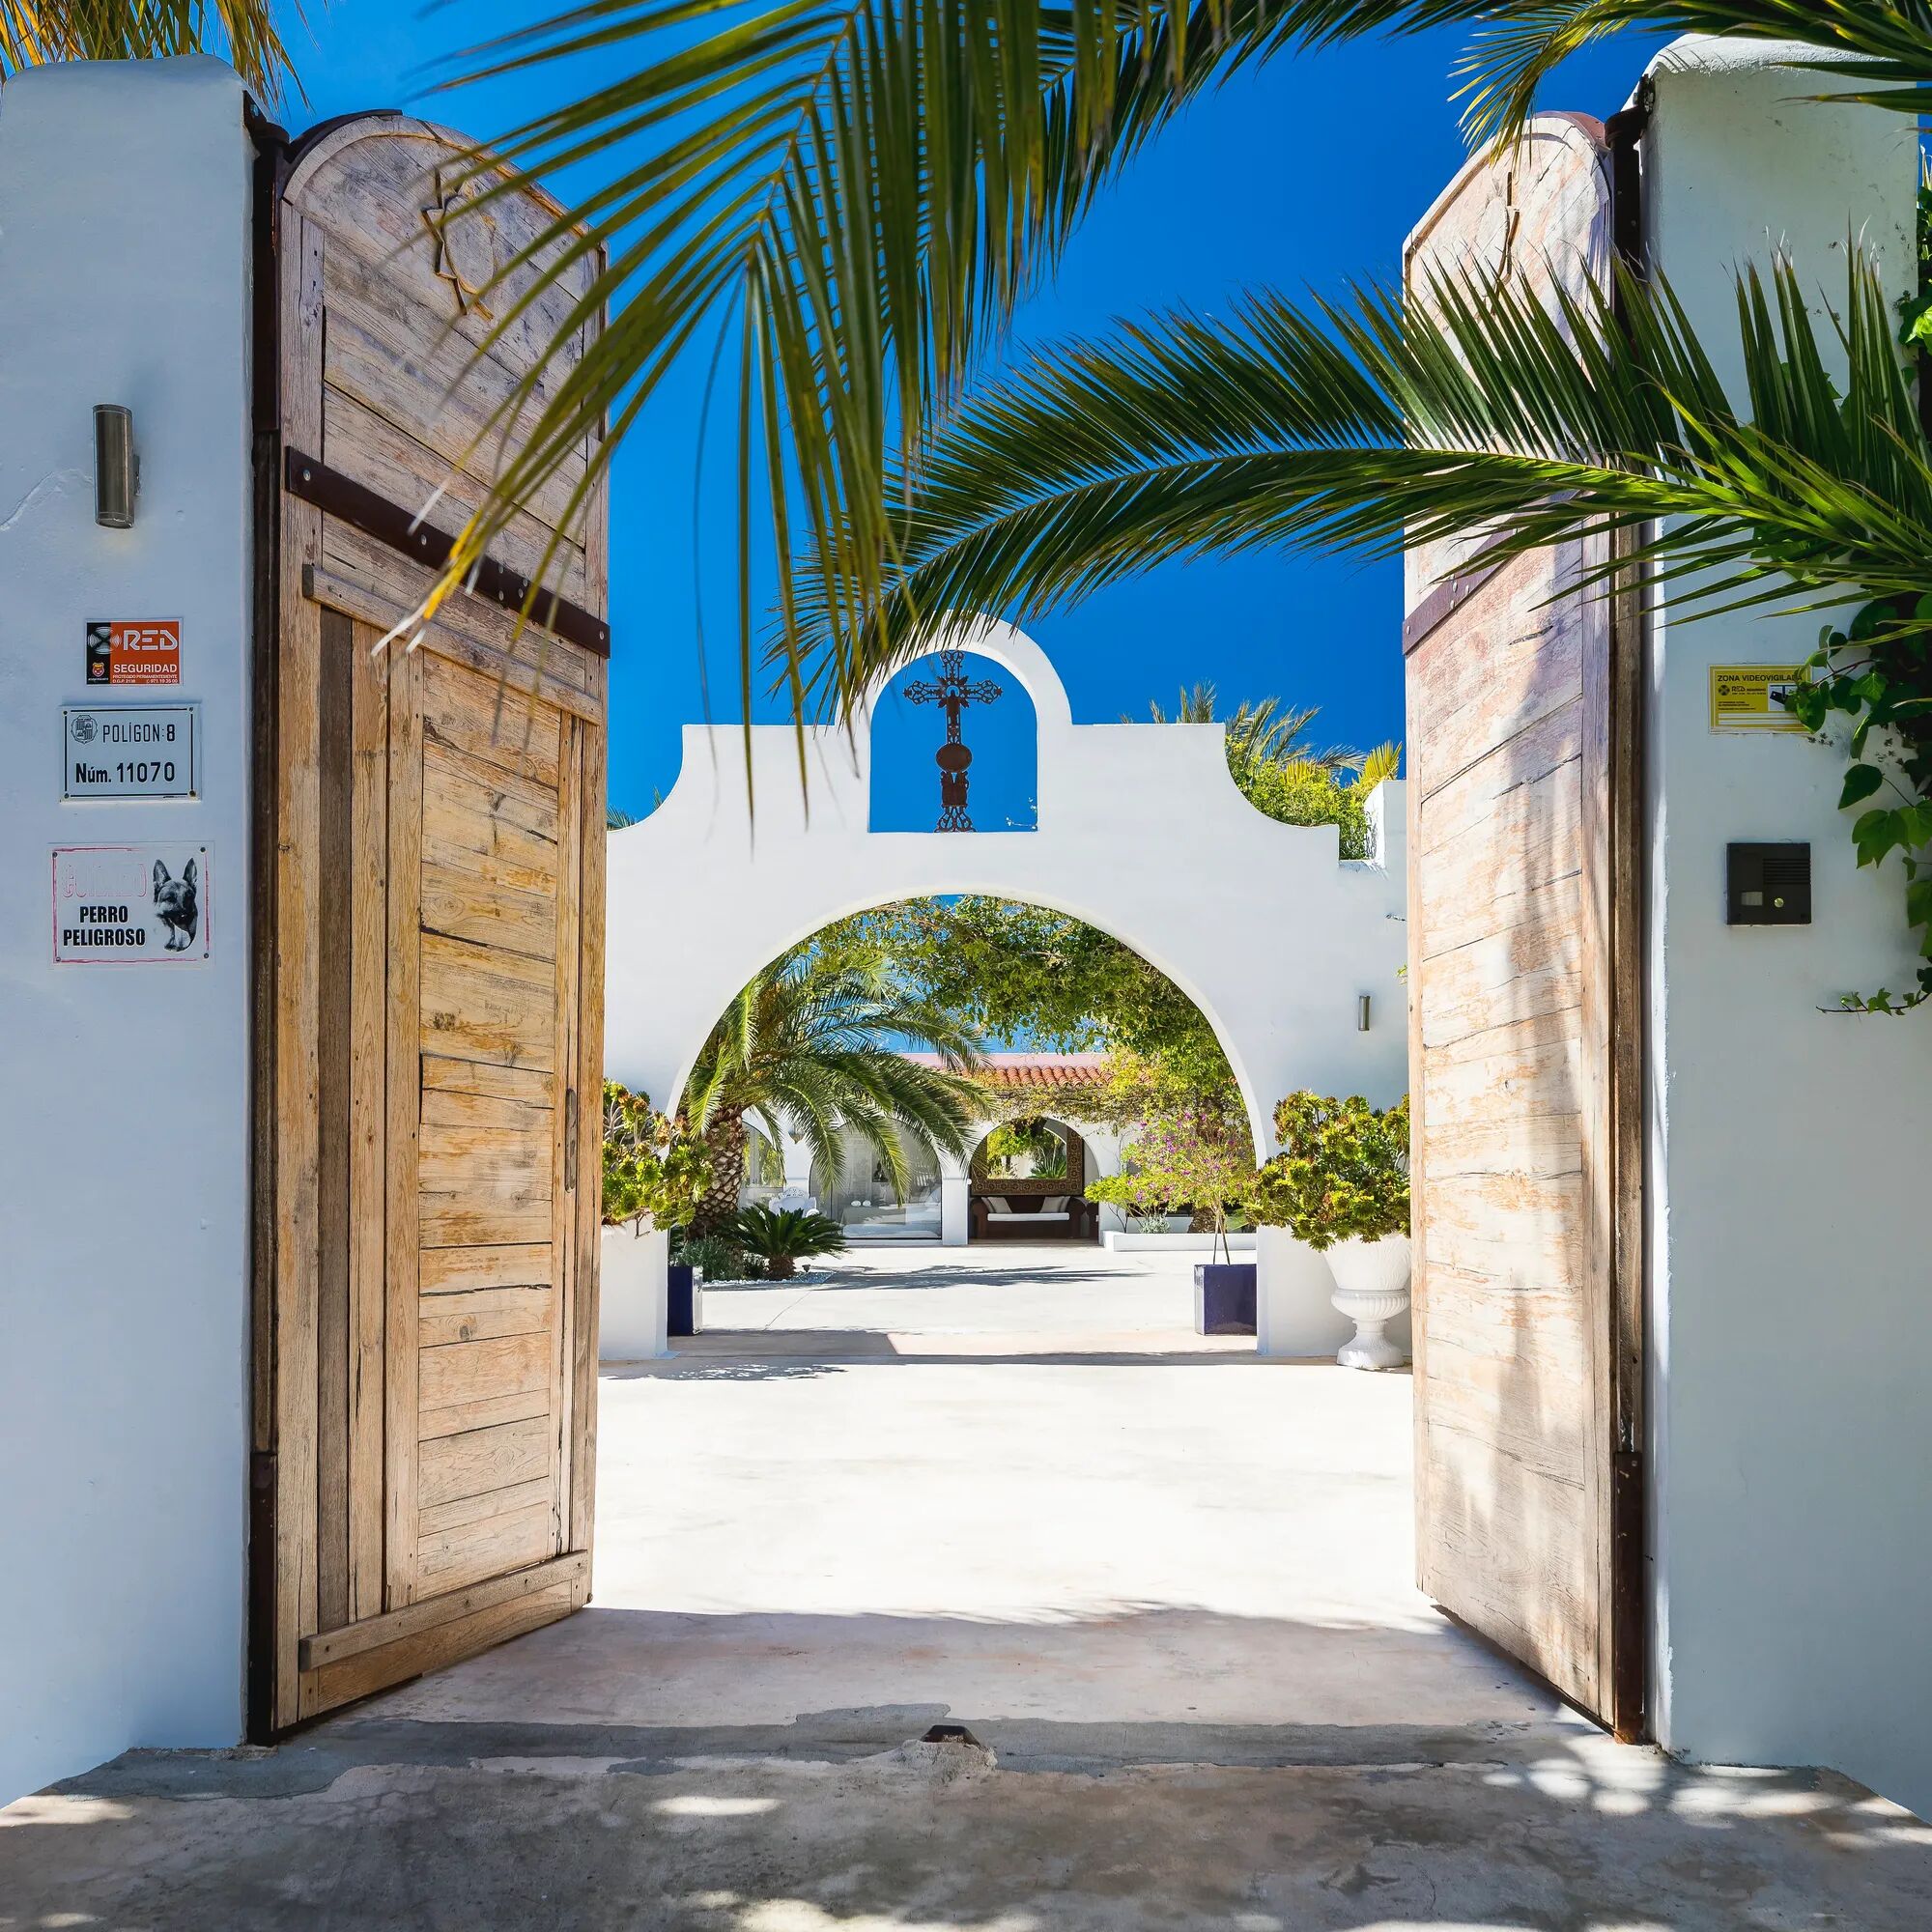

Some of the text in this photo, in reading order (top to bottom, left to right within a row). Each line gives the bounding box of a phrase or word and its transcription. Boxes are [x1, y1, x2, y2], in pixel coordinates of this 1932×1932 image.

[123, 630, 178, 651] RED
[113, 664, 178, 673] SEGURIDAD
[75, 761, 175, 783] Núm. 11070
[79, 905, 128, 923] PERRO
[63, 928, 146, 947] PELIGROSO
